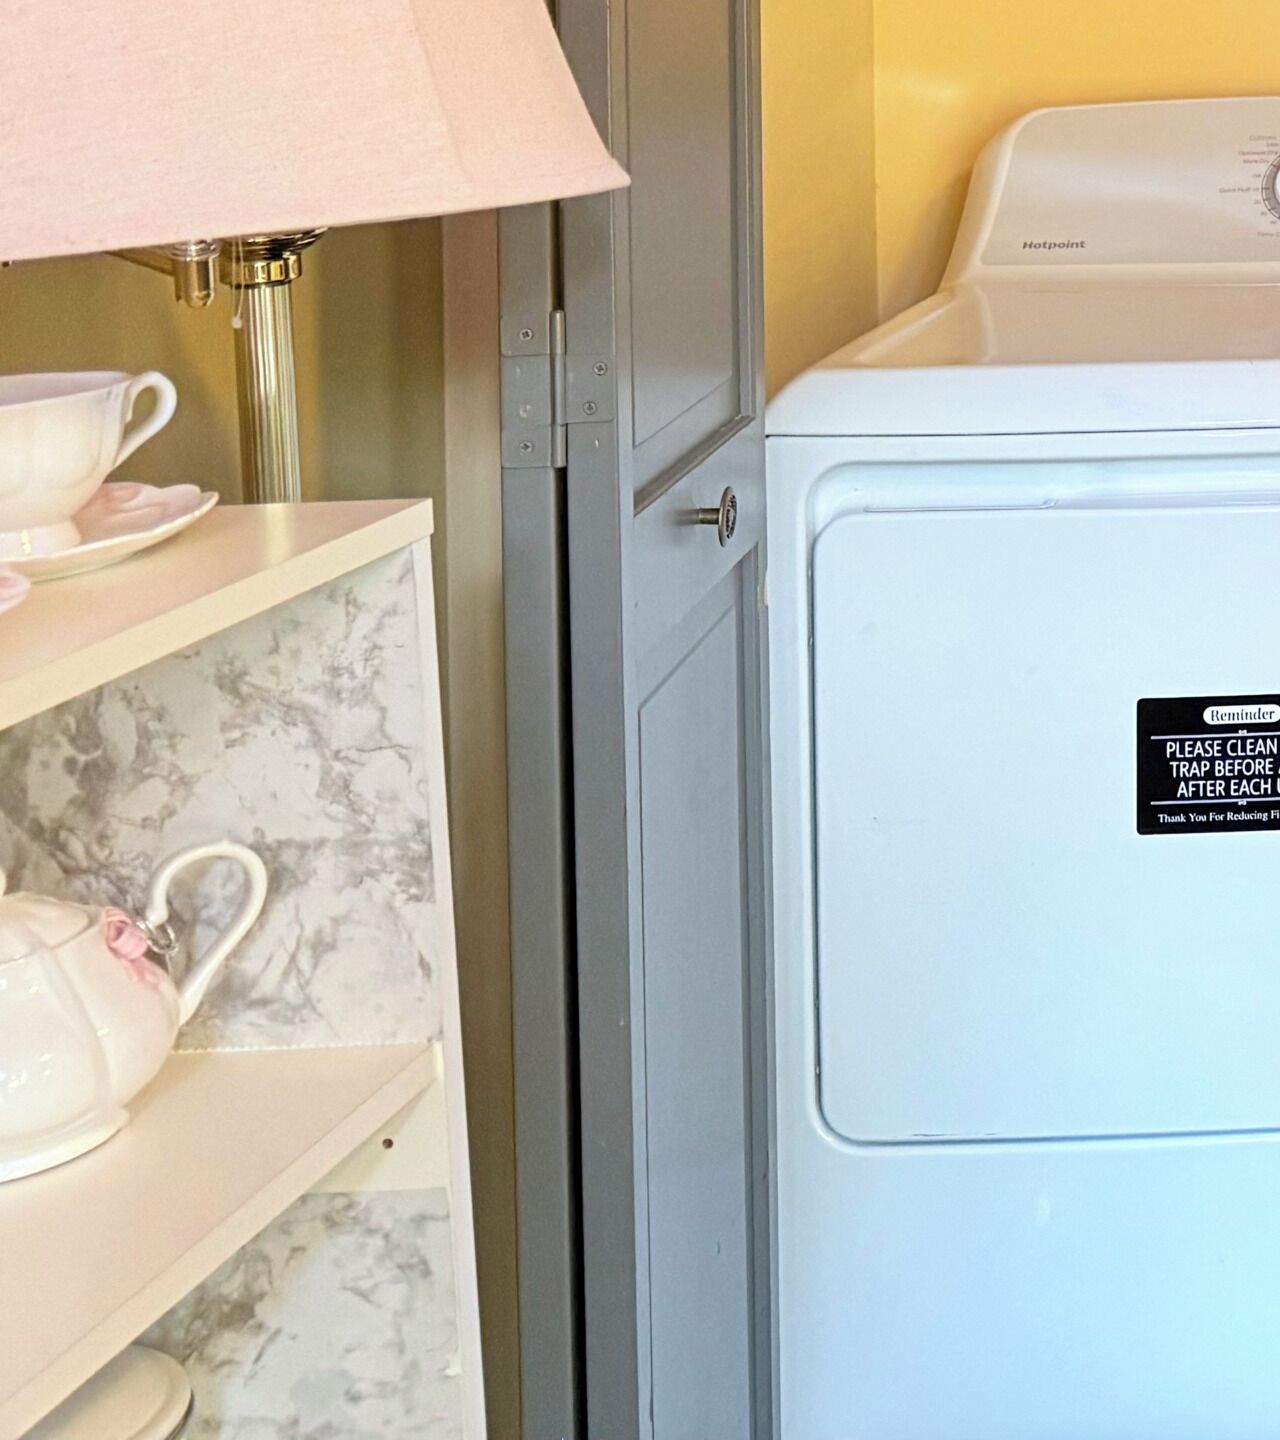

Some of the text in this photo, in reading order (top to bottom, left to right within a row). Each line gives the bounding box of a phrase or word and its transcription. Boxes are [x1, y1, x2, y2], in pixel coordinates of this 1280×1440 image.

[1022, 240, 1086, 251] Hotpoint
[1211, 707, 1275, 722] Reminder
[1166, 740, 1222, 758] PLEASE
[1227, 737, 1278, 756] CLEAN
[1170, 761, 1210, 778] TRAP
[1215, 759, 1273, 777] BEFORE
[1177, 780, 1225, 798] AFTER
[1230, 778, 1272, 796] EACH
[1157, 813, 1186, 824] Thank
[1189, 813, 1207, 822] You
[1209, 812, 1225, 821] For
[1227, 810, 1268, 822] Reducing
